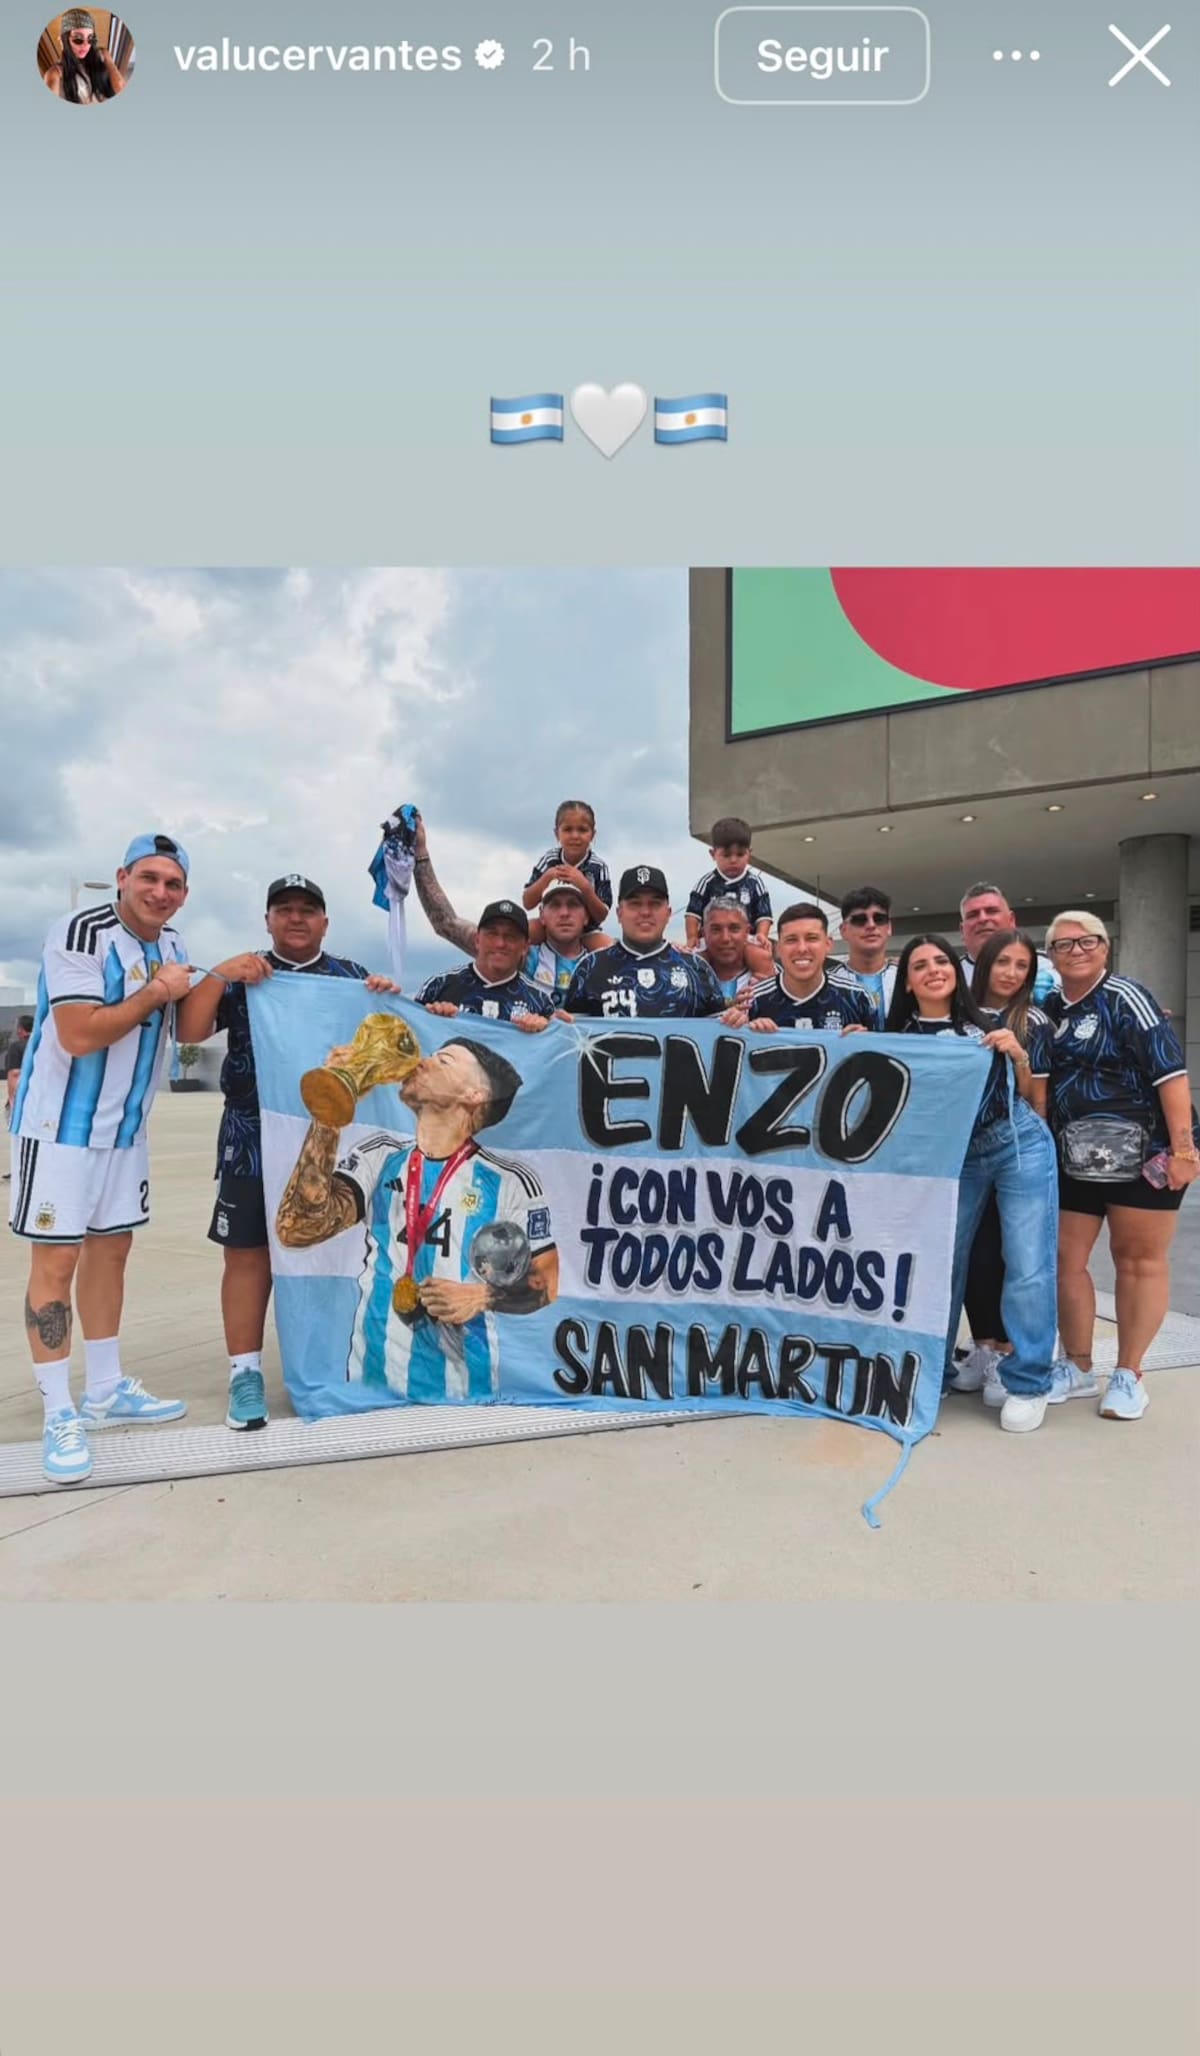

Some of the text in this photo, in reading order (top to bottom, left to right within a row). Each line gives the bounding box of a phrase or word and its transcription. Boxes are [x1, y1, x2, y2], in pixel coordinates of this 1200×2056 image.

[601, 990, 637, 1018] 24
[579, 1032, 911, 1164] ENZO
[397, 1200, 452, 1257] 4
[706, 1170, 794, 1236] VOS
[816, 1179, 852, 1242] A
[580, 1228, 913, 1322] TODOS LADOS!
[554, 1318, 921, 1428] SAN MARTIN
